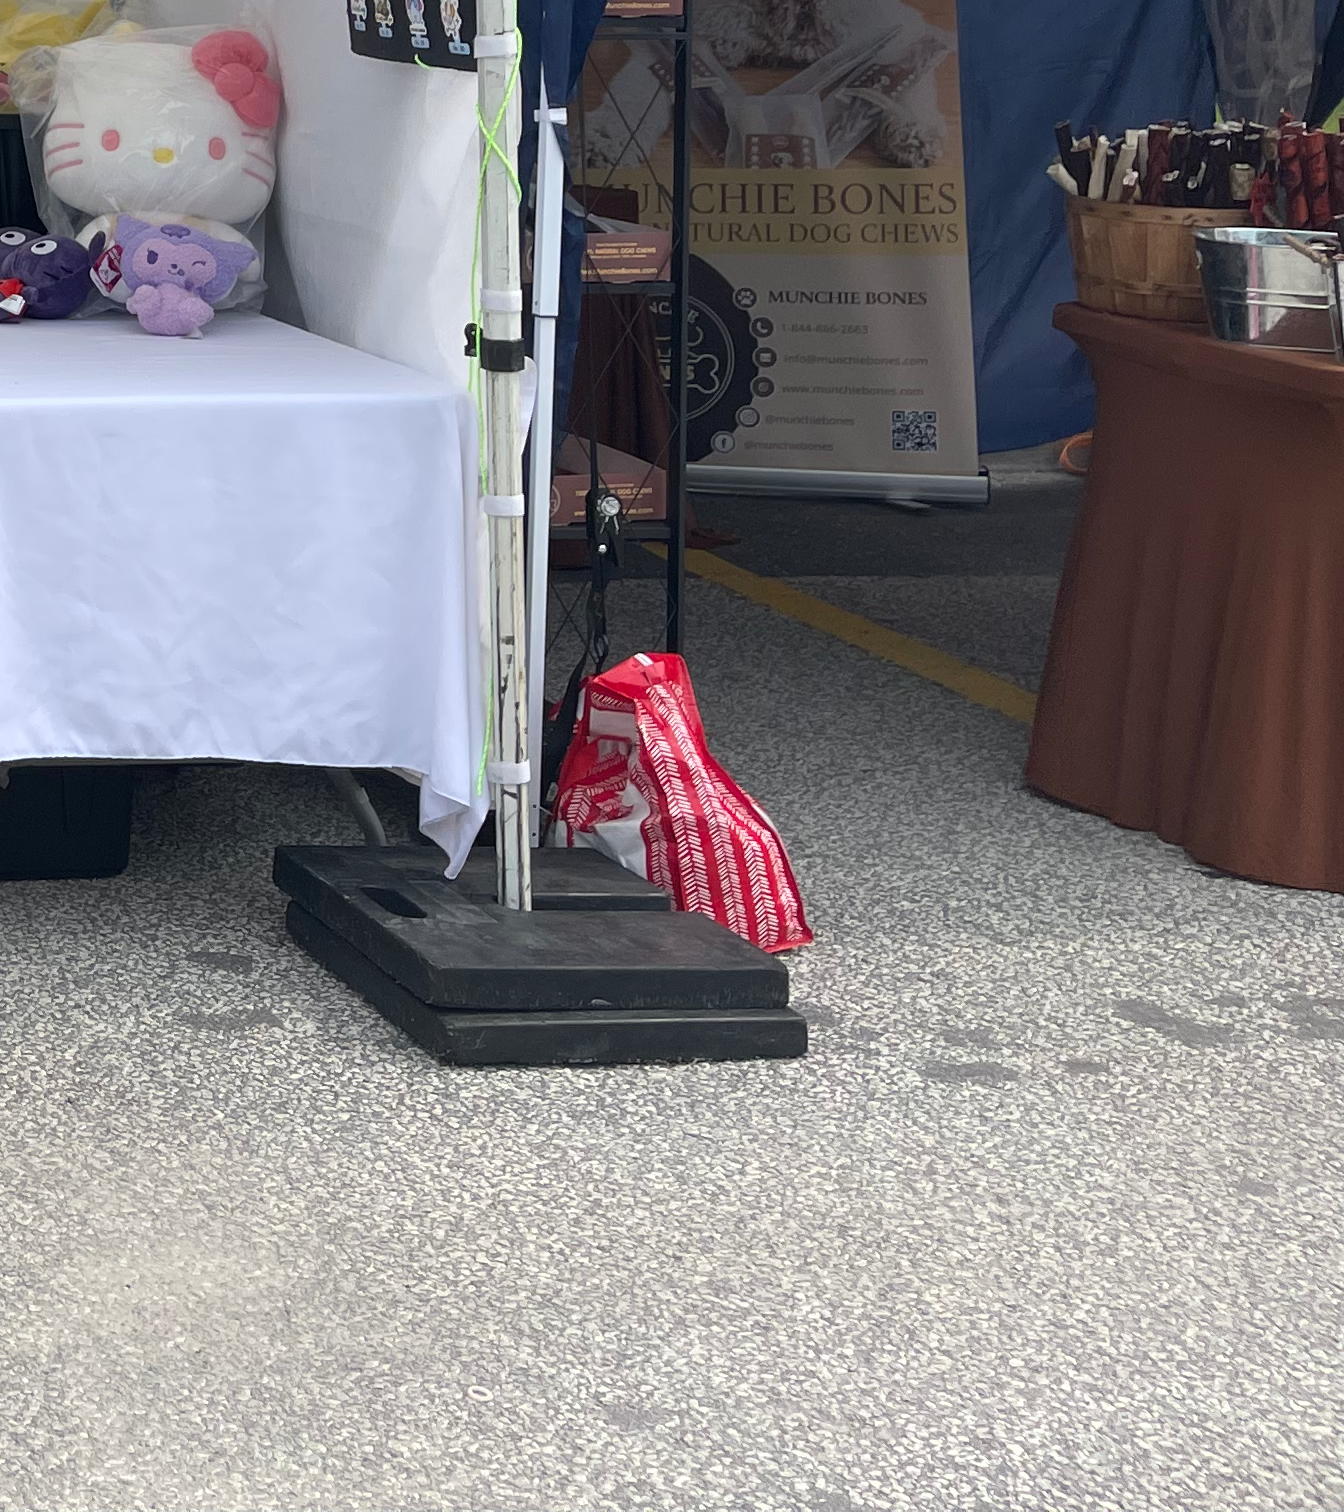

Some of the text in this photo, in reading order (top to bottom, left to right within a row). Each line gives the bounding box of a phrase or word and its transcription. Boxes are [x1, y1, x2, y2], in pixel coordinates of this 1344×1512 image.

[810, 181, 958, 216] BONES
[789, 222, 852, 244] DOG
[860, 222, 960, 244] CHEWS
[767, 290, 928, 306] MUNCHIE BONES
